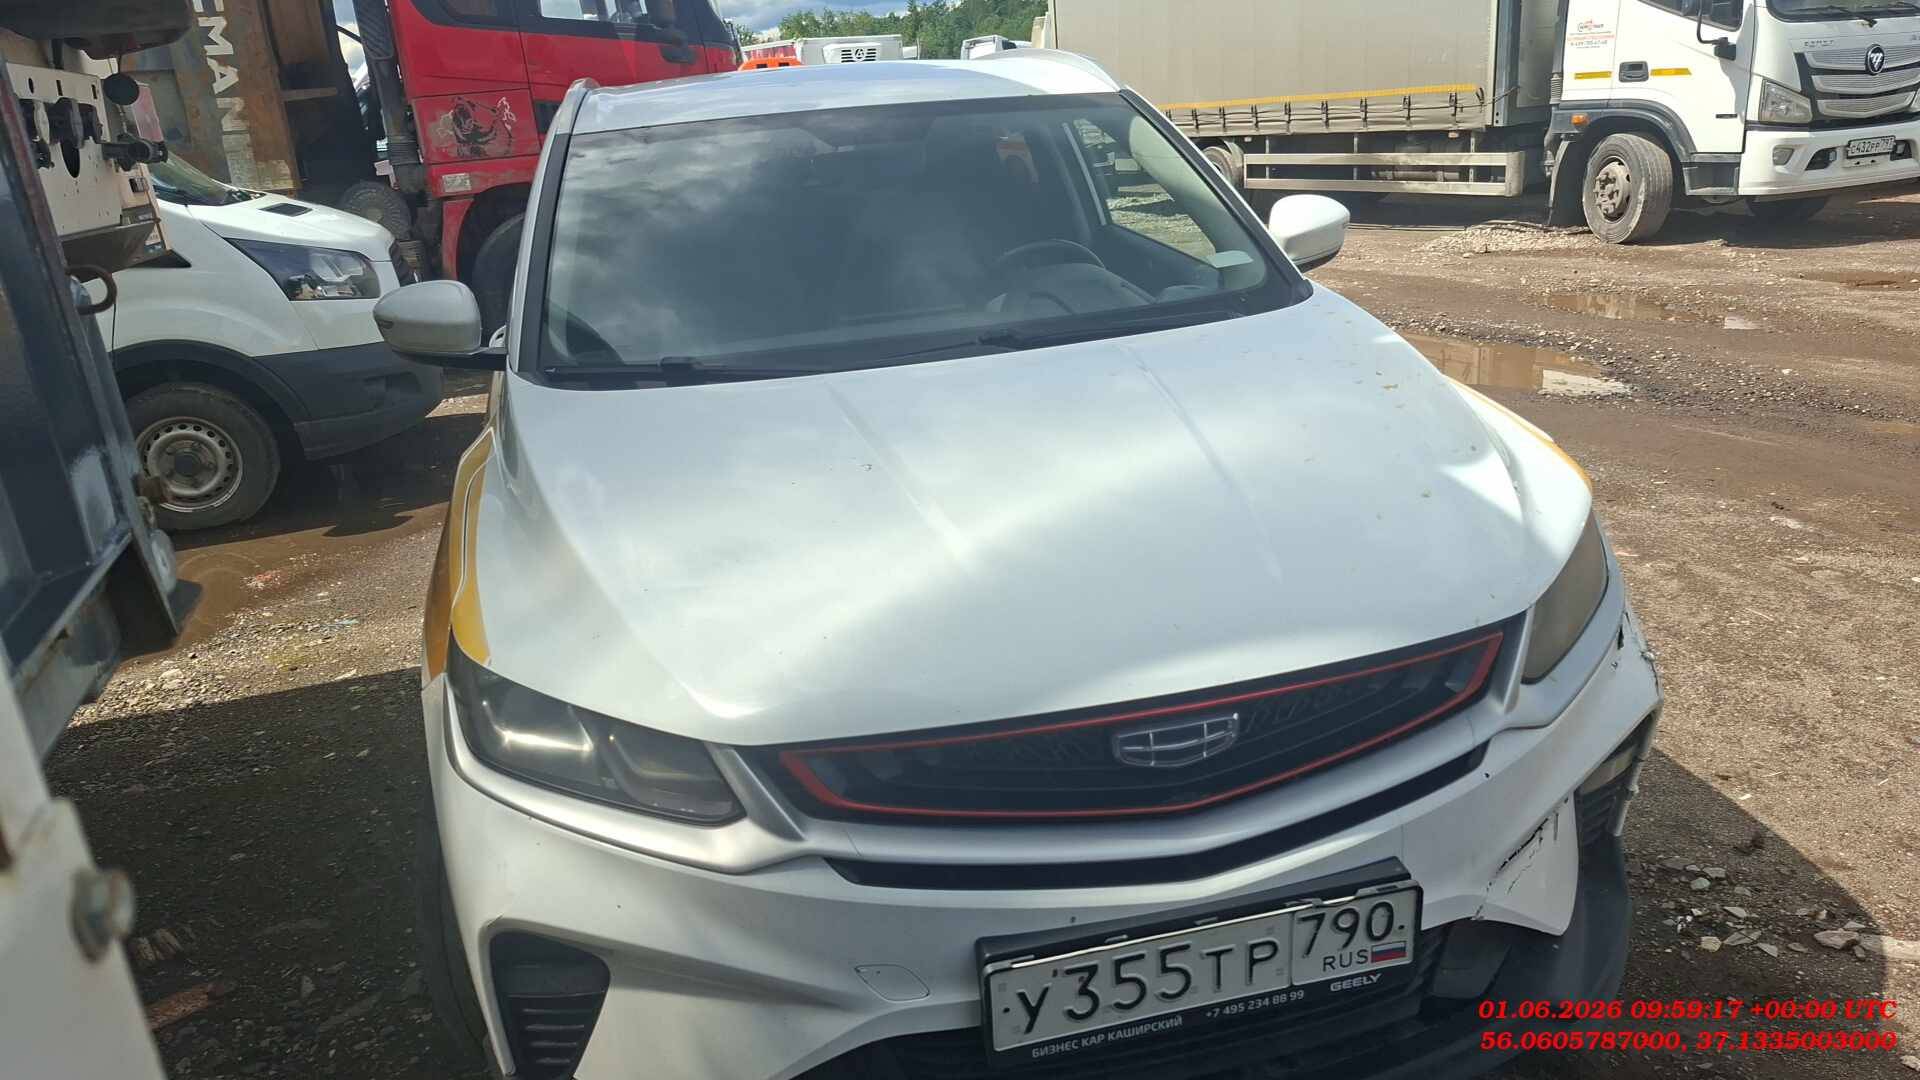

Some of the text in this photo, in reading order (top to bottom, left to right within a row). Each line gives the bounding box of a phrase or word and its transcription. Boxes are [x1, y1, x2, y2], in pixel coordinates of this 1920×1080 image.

[1016, 900, 1395, 1034] У355ТР 790
[1322, 948, 1369, 971] RUS
[1329, 973, 1382, 992] GEELY
[1205, 989, 1305, 1018] +7 495 234 88 99
[1031, 1014, 1184, 1058] БИЗНЕС КАР КАШИРСКИЙ
